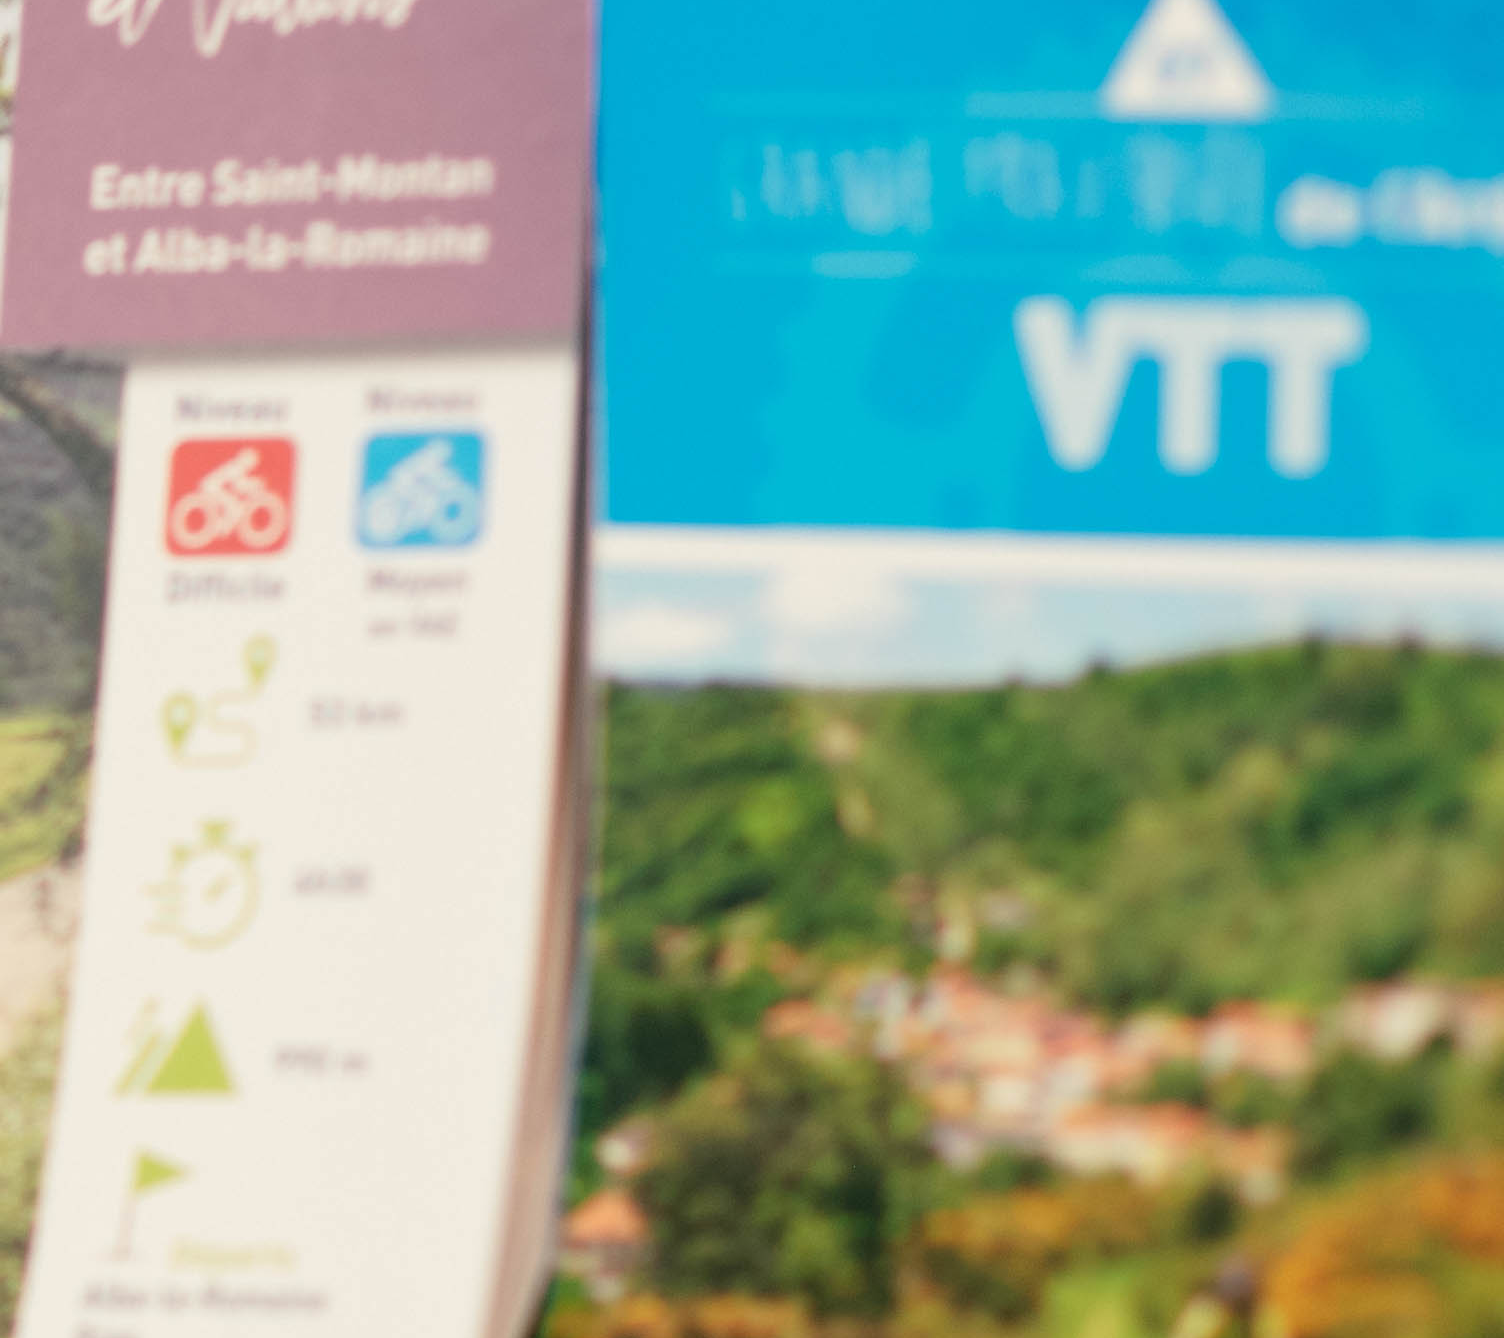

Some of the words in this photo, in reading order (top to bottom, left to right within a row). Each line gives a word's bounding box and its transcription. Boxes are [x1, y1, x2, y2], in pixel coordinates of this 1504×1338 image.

[90, 162, 205, 211] Entre
[84, 231, 127, 276] et
[1014, 294, 1368, 478] VTT
